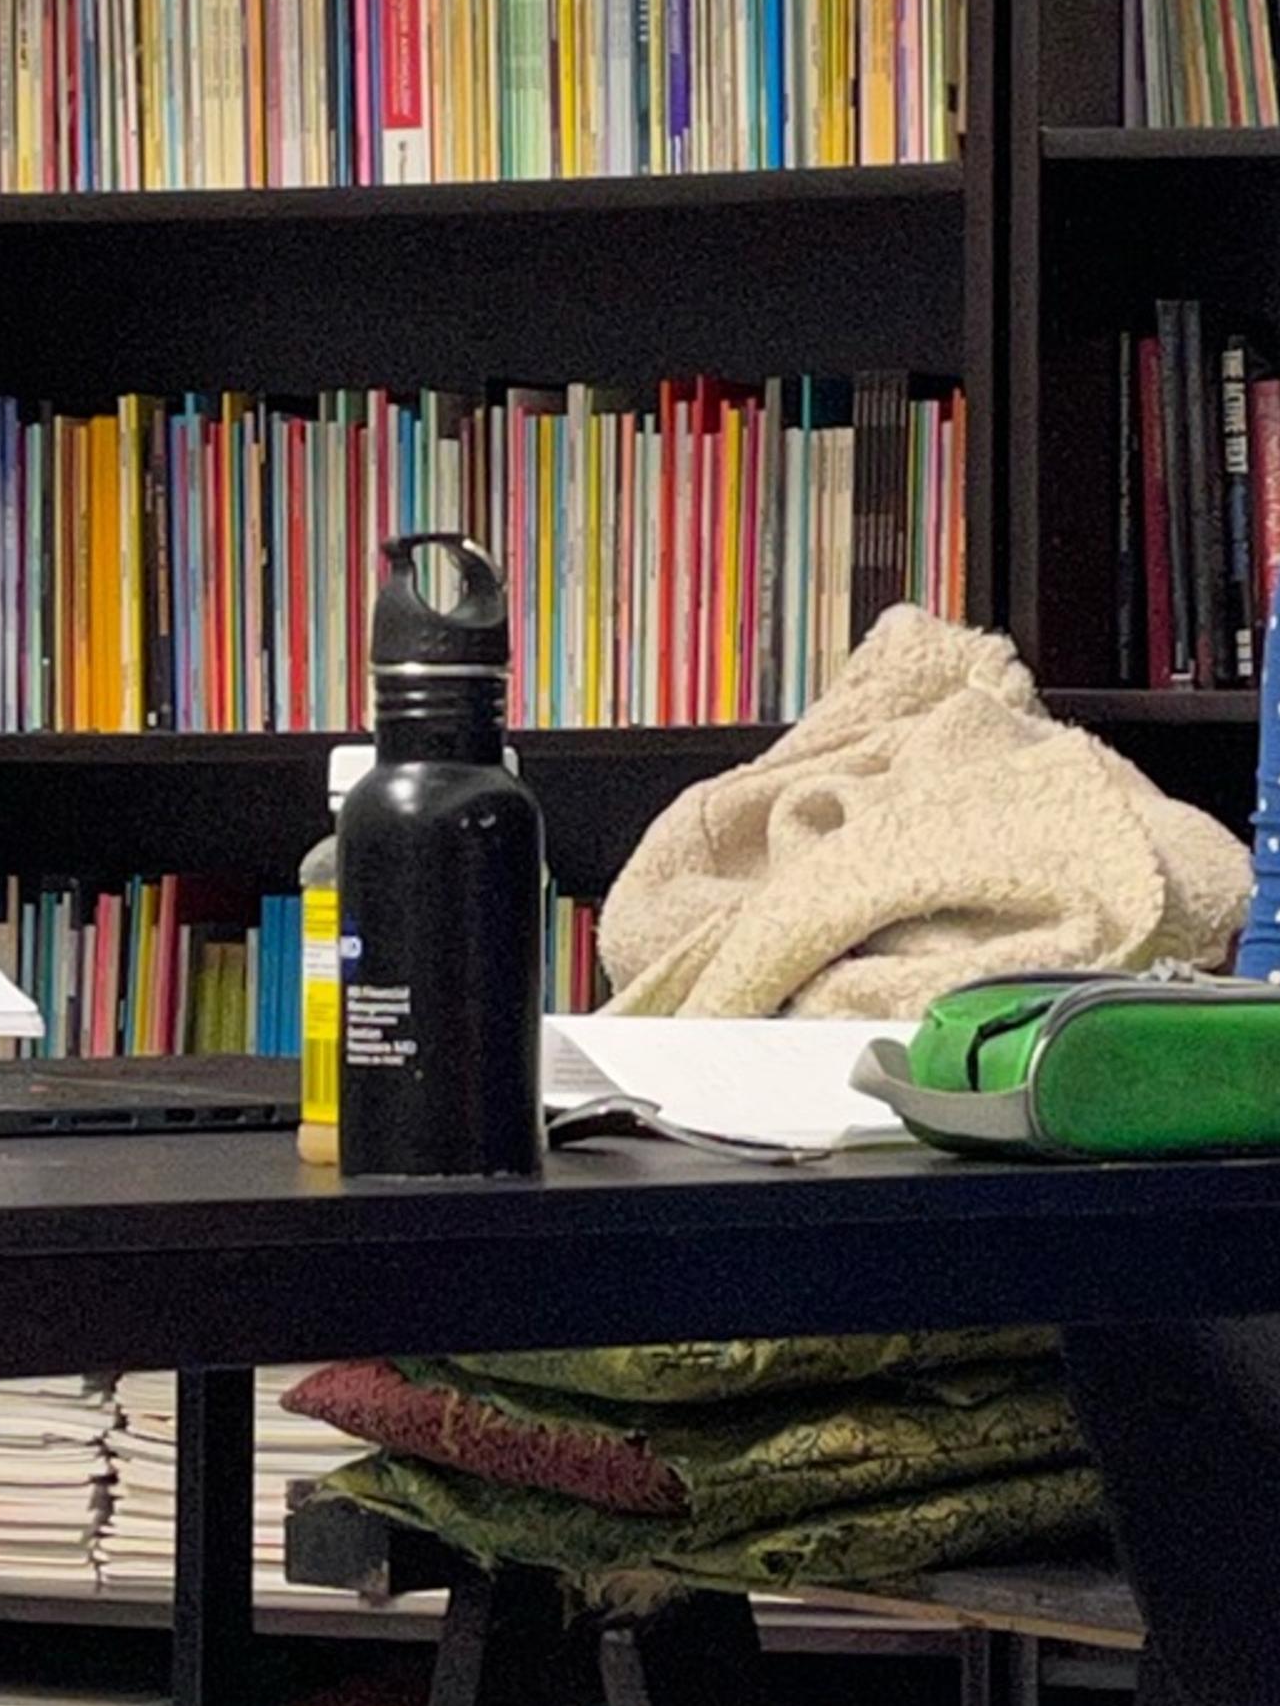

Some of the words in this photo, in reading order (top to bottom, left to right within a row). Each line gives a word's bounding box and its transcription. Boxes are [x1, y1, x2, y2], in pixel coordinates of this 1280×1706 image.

[1221, 349, 1245, 378] THE
[1222, 381, 1247, 436] ACTIVE
[1224, 436, 1248, 474] TEXT
